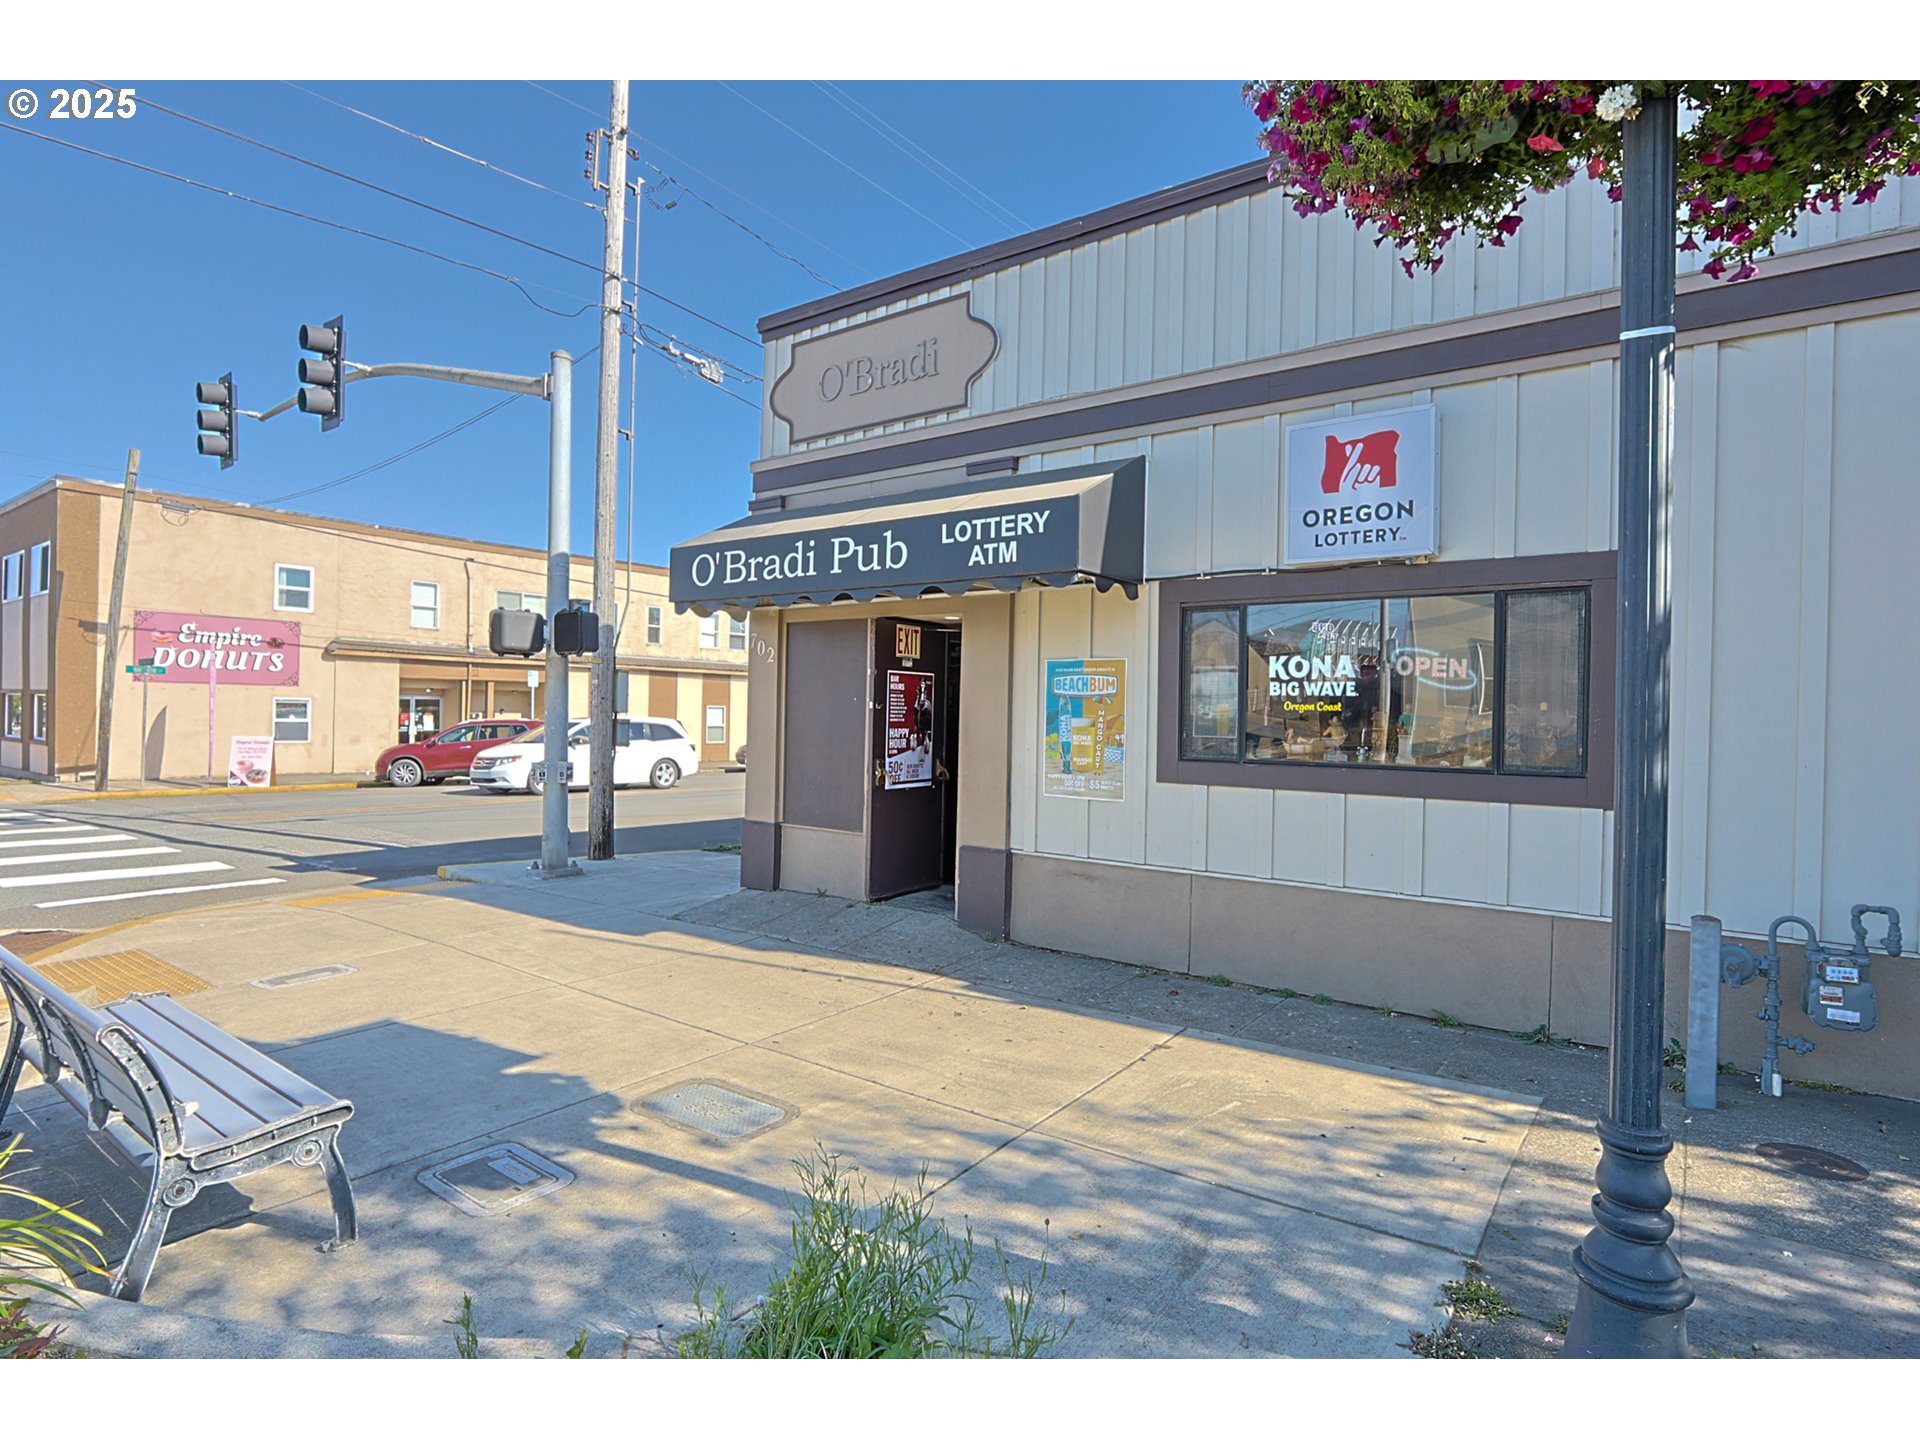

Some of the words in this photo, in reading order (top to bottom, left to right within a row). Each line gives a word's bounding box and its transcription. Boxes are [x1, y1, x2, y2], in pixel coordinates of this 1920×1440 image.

[819, 337, 940, 402] O'Bradi
[941, 510, 1051, 545] LOTTERY
[1302, 500, 1414, 528] OREGON
[1315, 527, 1401, 548] LOTTERY
[691, 540, 817, 587] O'Bradi
[829, 530, 908, 575] Pub
[968, 541, 1018, 567] ATM
[177, 621, 263, 650] Empire
[751, 632, 775, 664] 702
[897, 627, 920, 656] EXIT
[1269, 655, 1355, 681] KONA
[1396, 656, 1468, 679] OPEN
[1283, 701, 1315, 714] Oregon
[1316, 701, 1343, 712] Coast
[889, 728, 909, 738] HAPPY
[1097, 710, 1105, 741] MANGO
[889, 739, 907, 749] HOUR
[1095, 744, 1103, 769] CART
